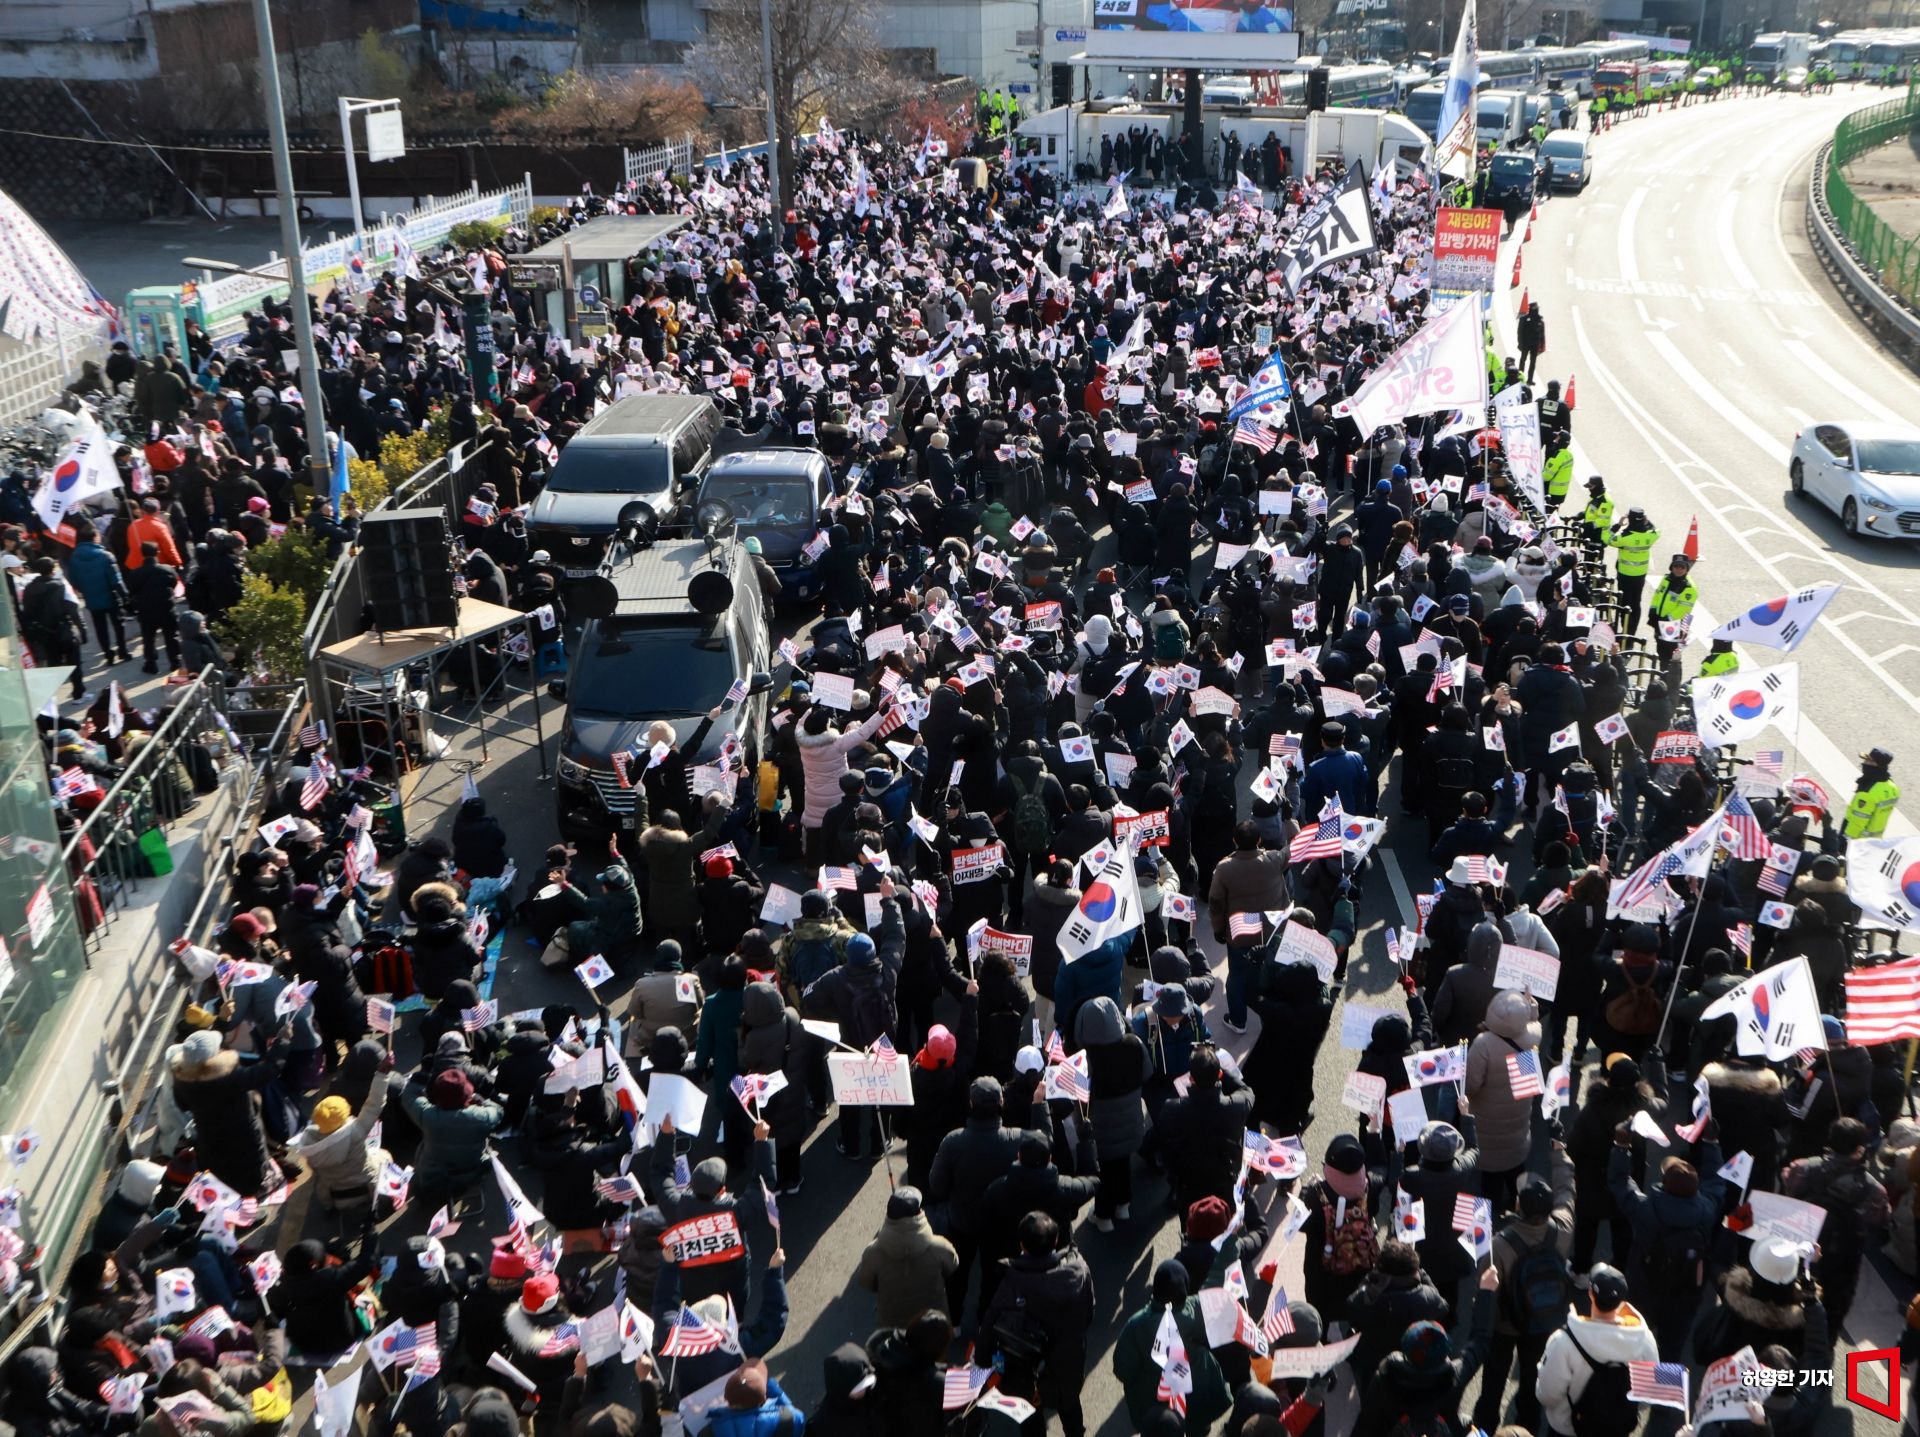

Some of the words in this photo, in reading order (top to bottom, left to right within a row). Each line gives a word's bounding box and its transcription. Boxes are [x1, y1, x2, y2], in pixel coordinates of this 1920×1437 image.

[1448, 212, 1491, 230] 재명아!
[1439, 232, 1496, 250] 깜빵가자!
[954, 846, 1000, 869] 탄핵반대
[954, 867, 984, 882] 이재명
[981, 934, 1030, 954] 탄핵반대
[843, 1062, 897, 1078] STOP
[854, 1077, 889, 1089] THE
[841, 1089, 905, 1105] STEAL
